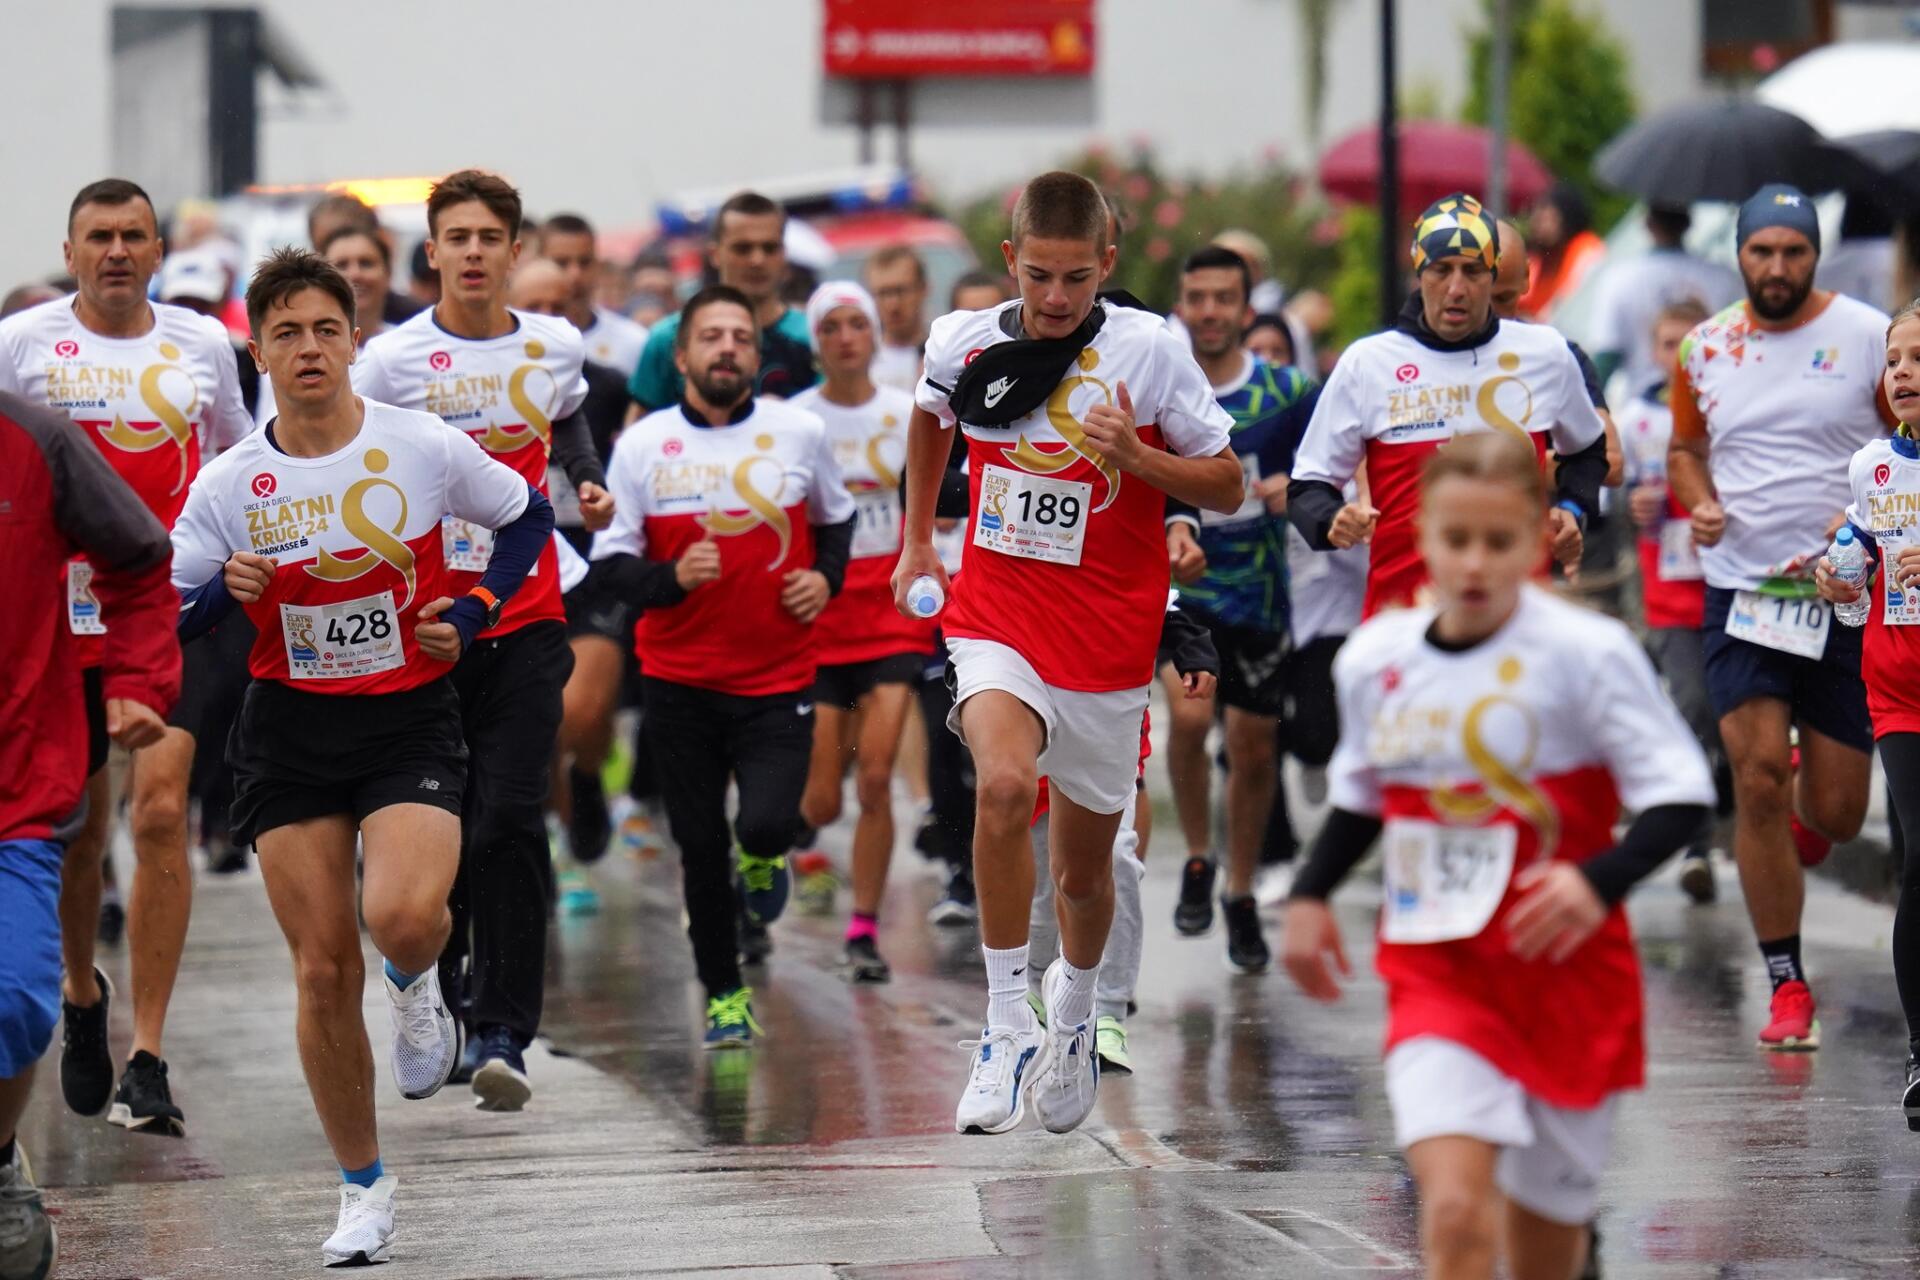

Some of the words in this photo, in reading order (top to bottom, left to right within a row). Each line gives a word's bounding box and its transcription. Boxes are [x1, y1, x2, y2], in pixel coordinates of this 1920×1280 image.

[47, 368, 132, 384] ZLATNI
[424, 374, 501, 399] ZLATNI
[987, 376, 1007, 397] NIKE
[1389, 385, 1471, 412] ZLATNI
[244, 503, 260, 512] SRCE
[262, 501, 271, 509] ZA
[272, 495, 291, 506] DJECU
[245, 495, 335, 533] ZLATNI
[1018, 490, 1080, 528] 189
[250, 524, 300, 549] KRUG
[255, 540, 299, 556] SPARKASSE
[1774, 598, 1823, 629] 110
[326, 609, 391, 647] 428
